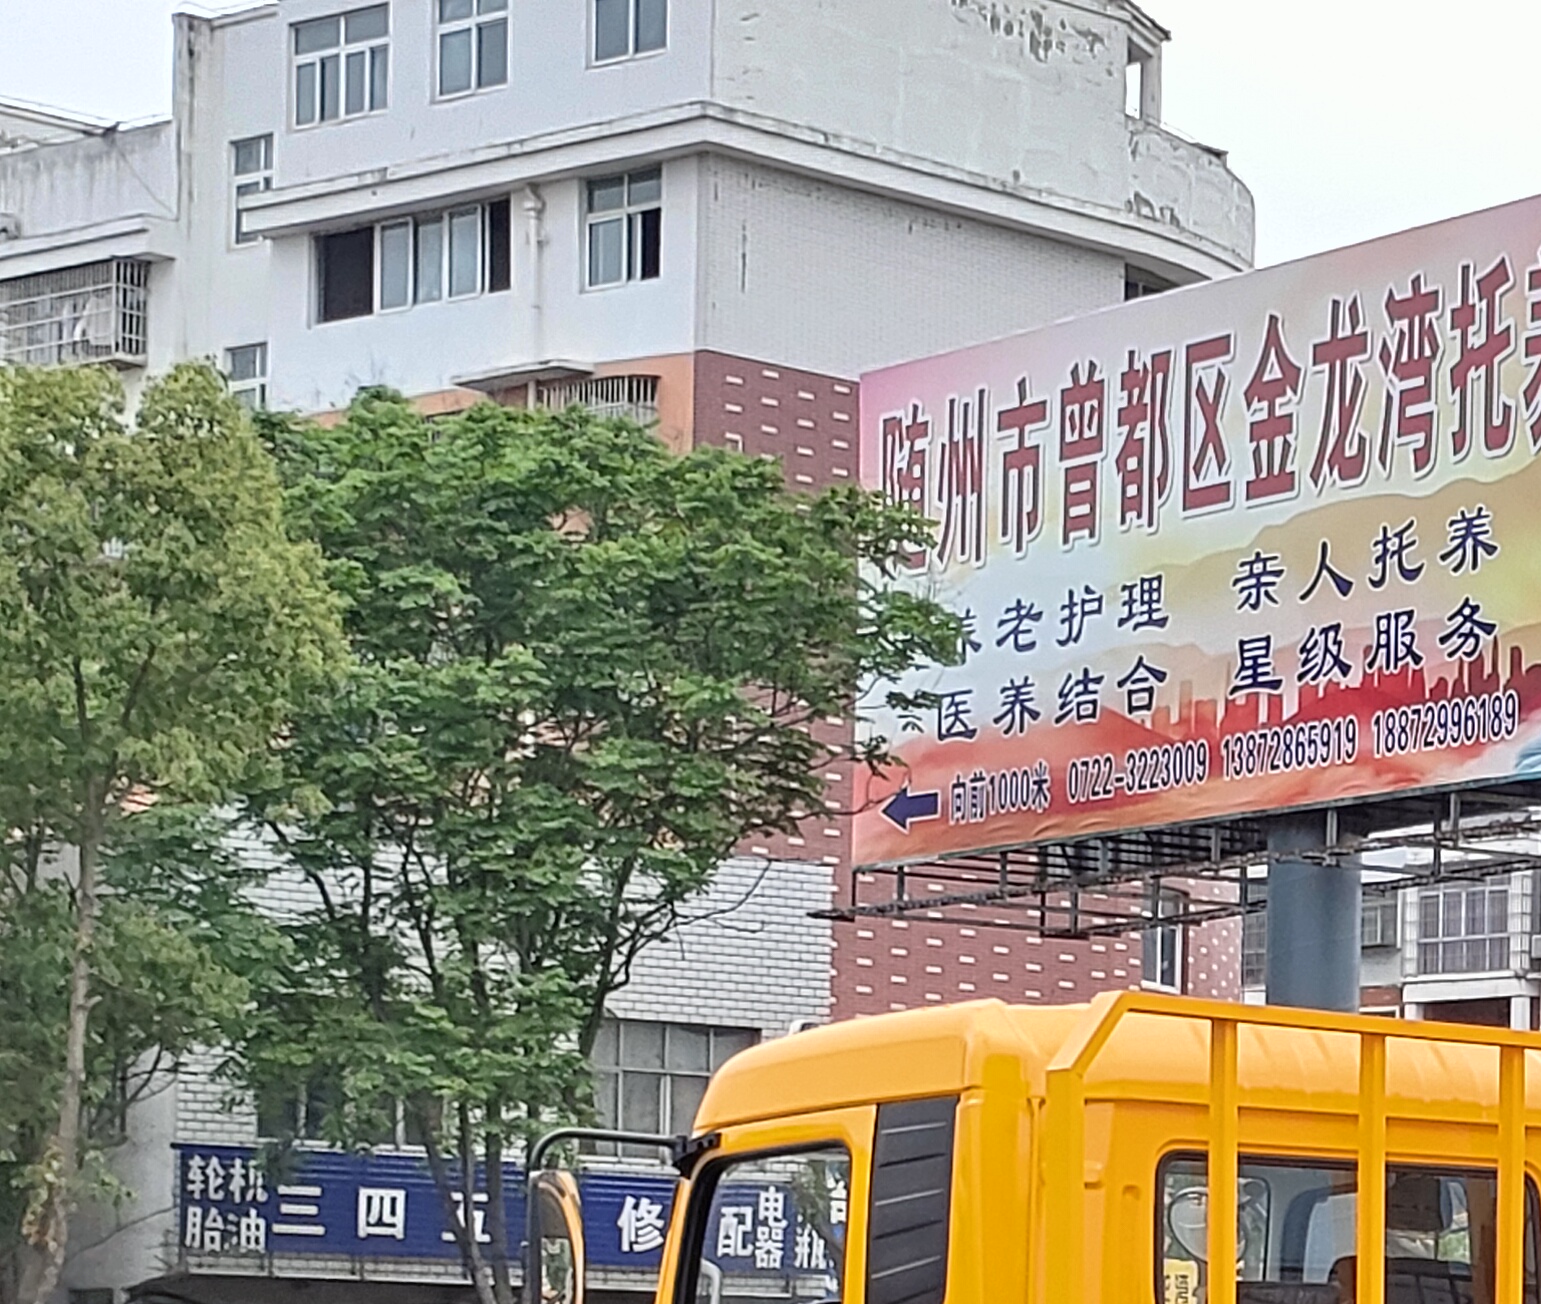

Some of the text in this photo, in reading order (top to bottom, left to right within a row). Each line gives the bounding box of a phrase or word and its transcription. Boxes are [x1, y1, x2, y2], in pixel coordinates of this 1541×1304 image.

[1232, 506, 1498, 611] 亲人托养
[937, 599, 1498, 741] 医养结合 星级服务
[950, 691, 1518, 823] 向前1000米 0722-3223009 13872865919 18872996189
